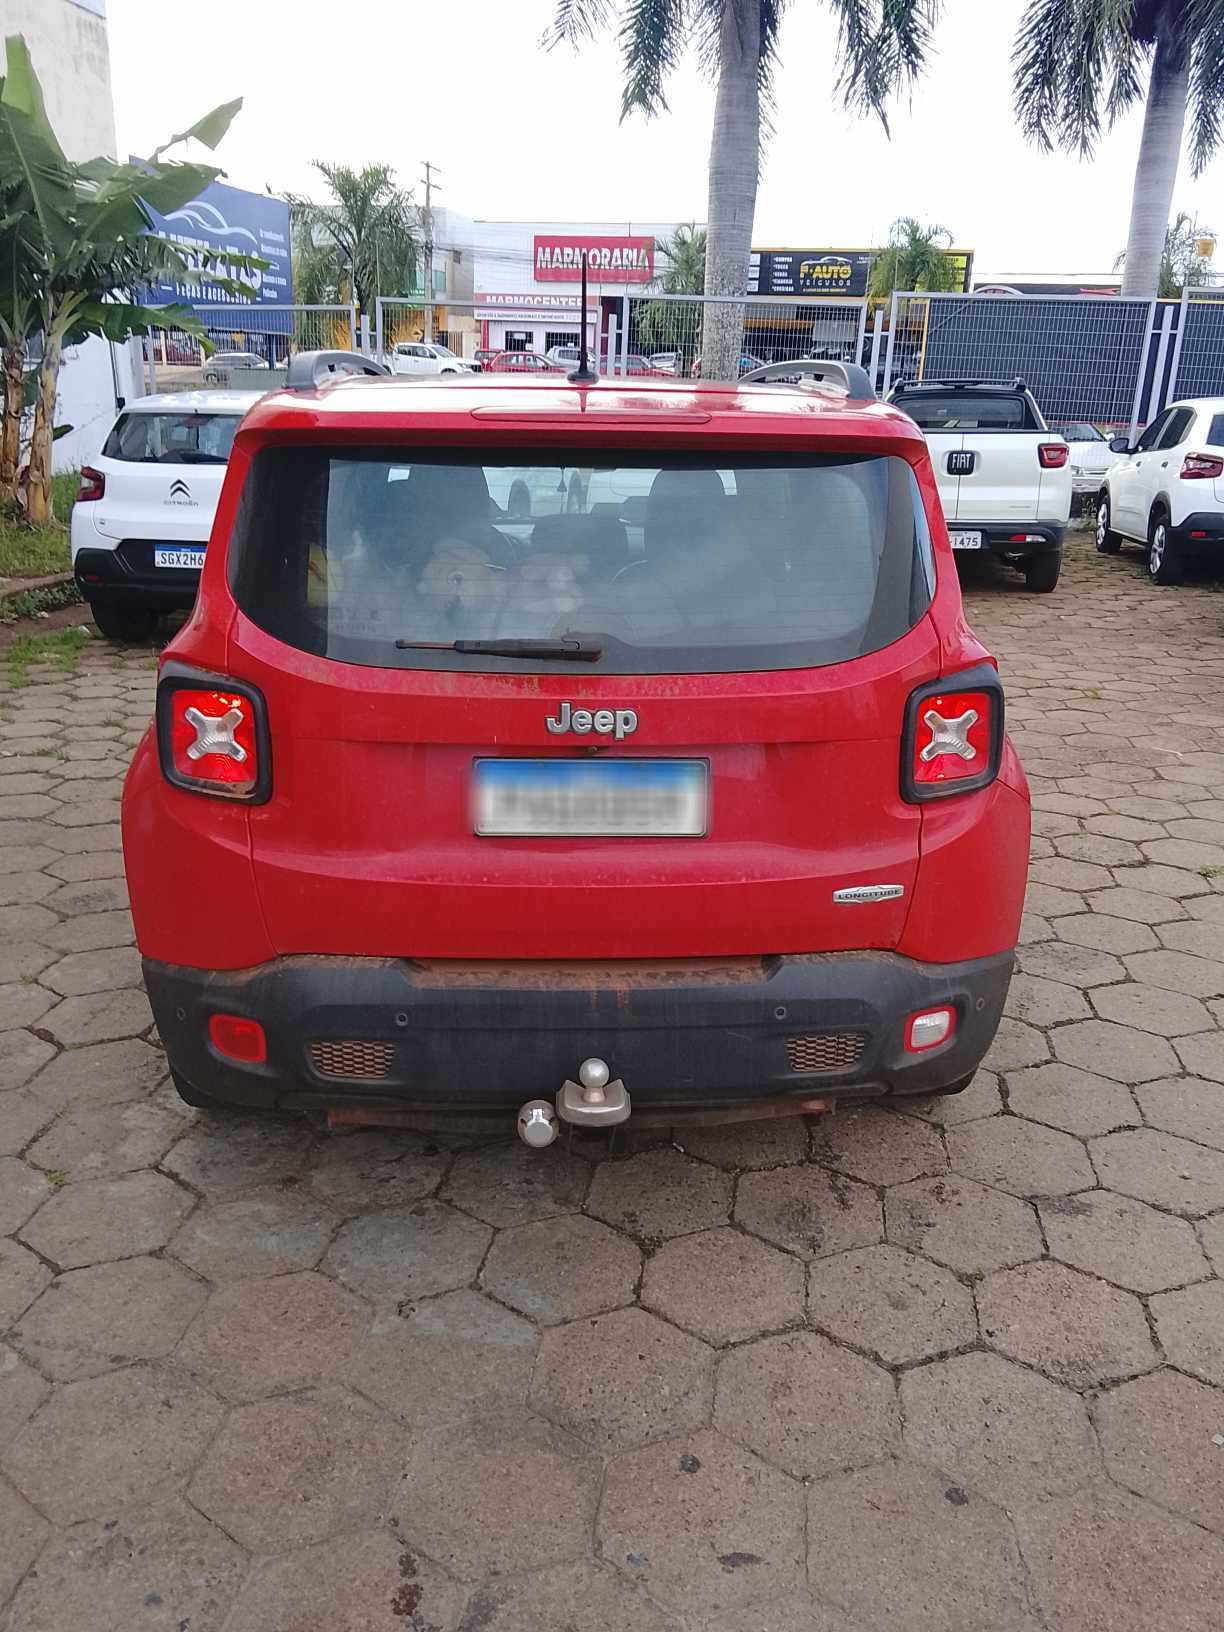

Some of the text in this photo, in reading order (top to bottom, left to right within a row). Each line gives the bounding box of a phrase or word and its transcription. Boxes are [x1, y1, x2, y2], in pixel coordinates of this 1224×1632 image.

[537, 246, 649, 271] MARMORARIA
[952, 453, 972, 469] FIAT
[545, 701, 639, 740] Jeep
[837, 889, 901, 900] LONGITUDE
